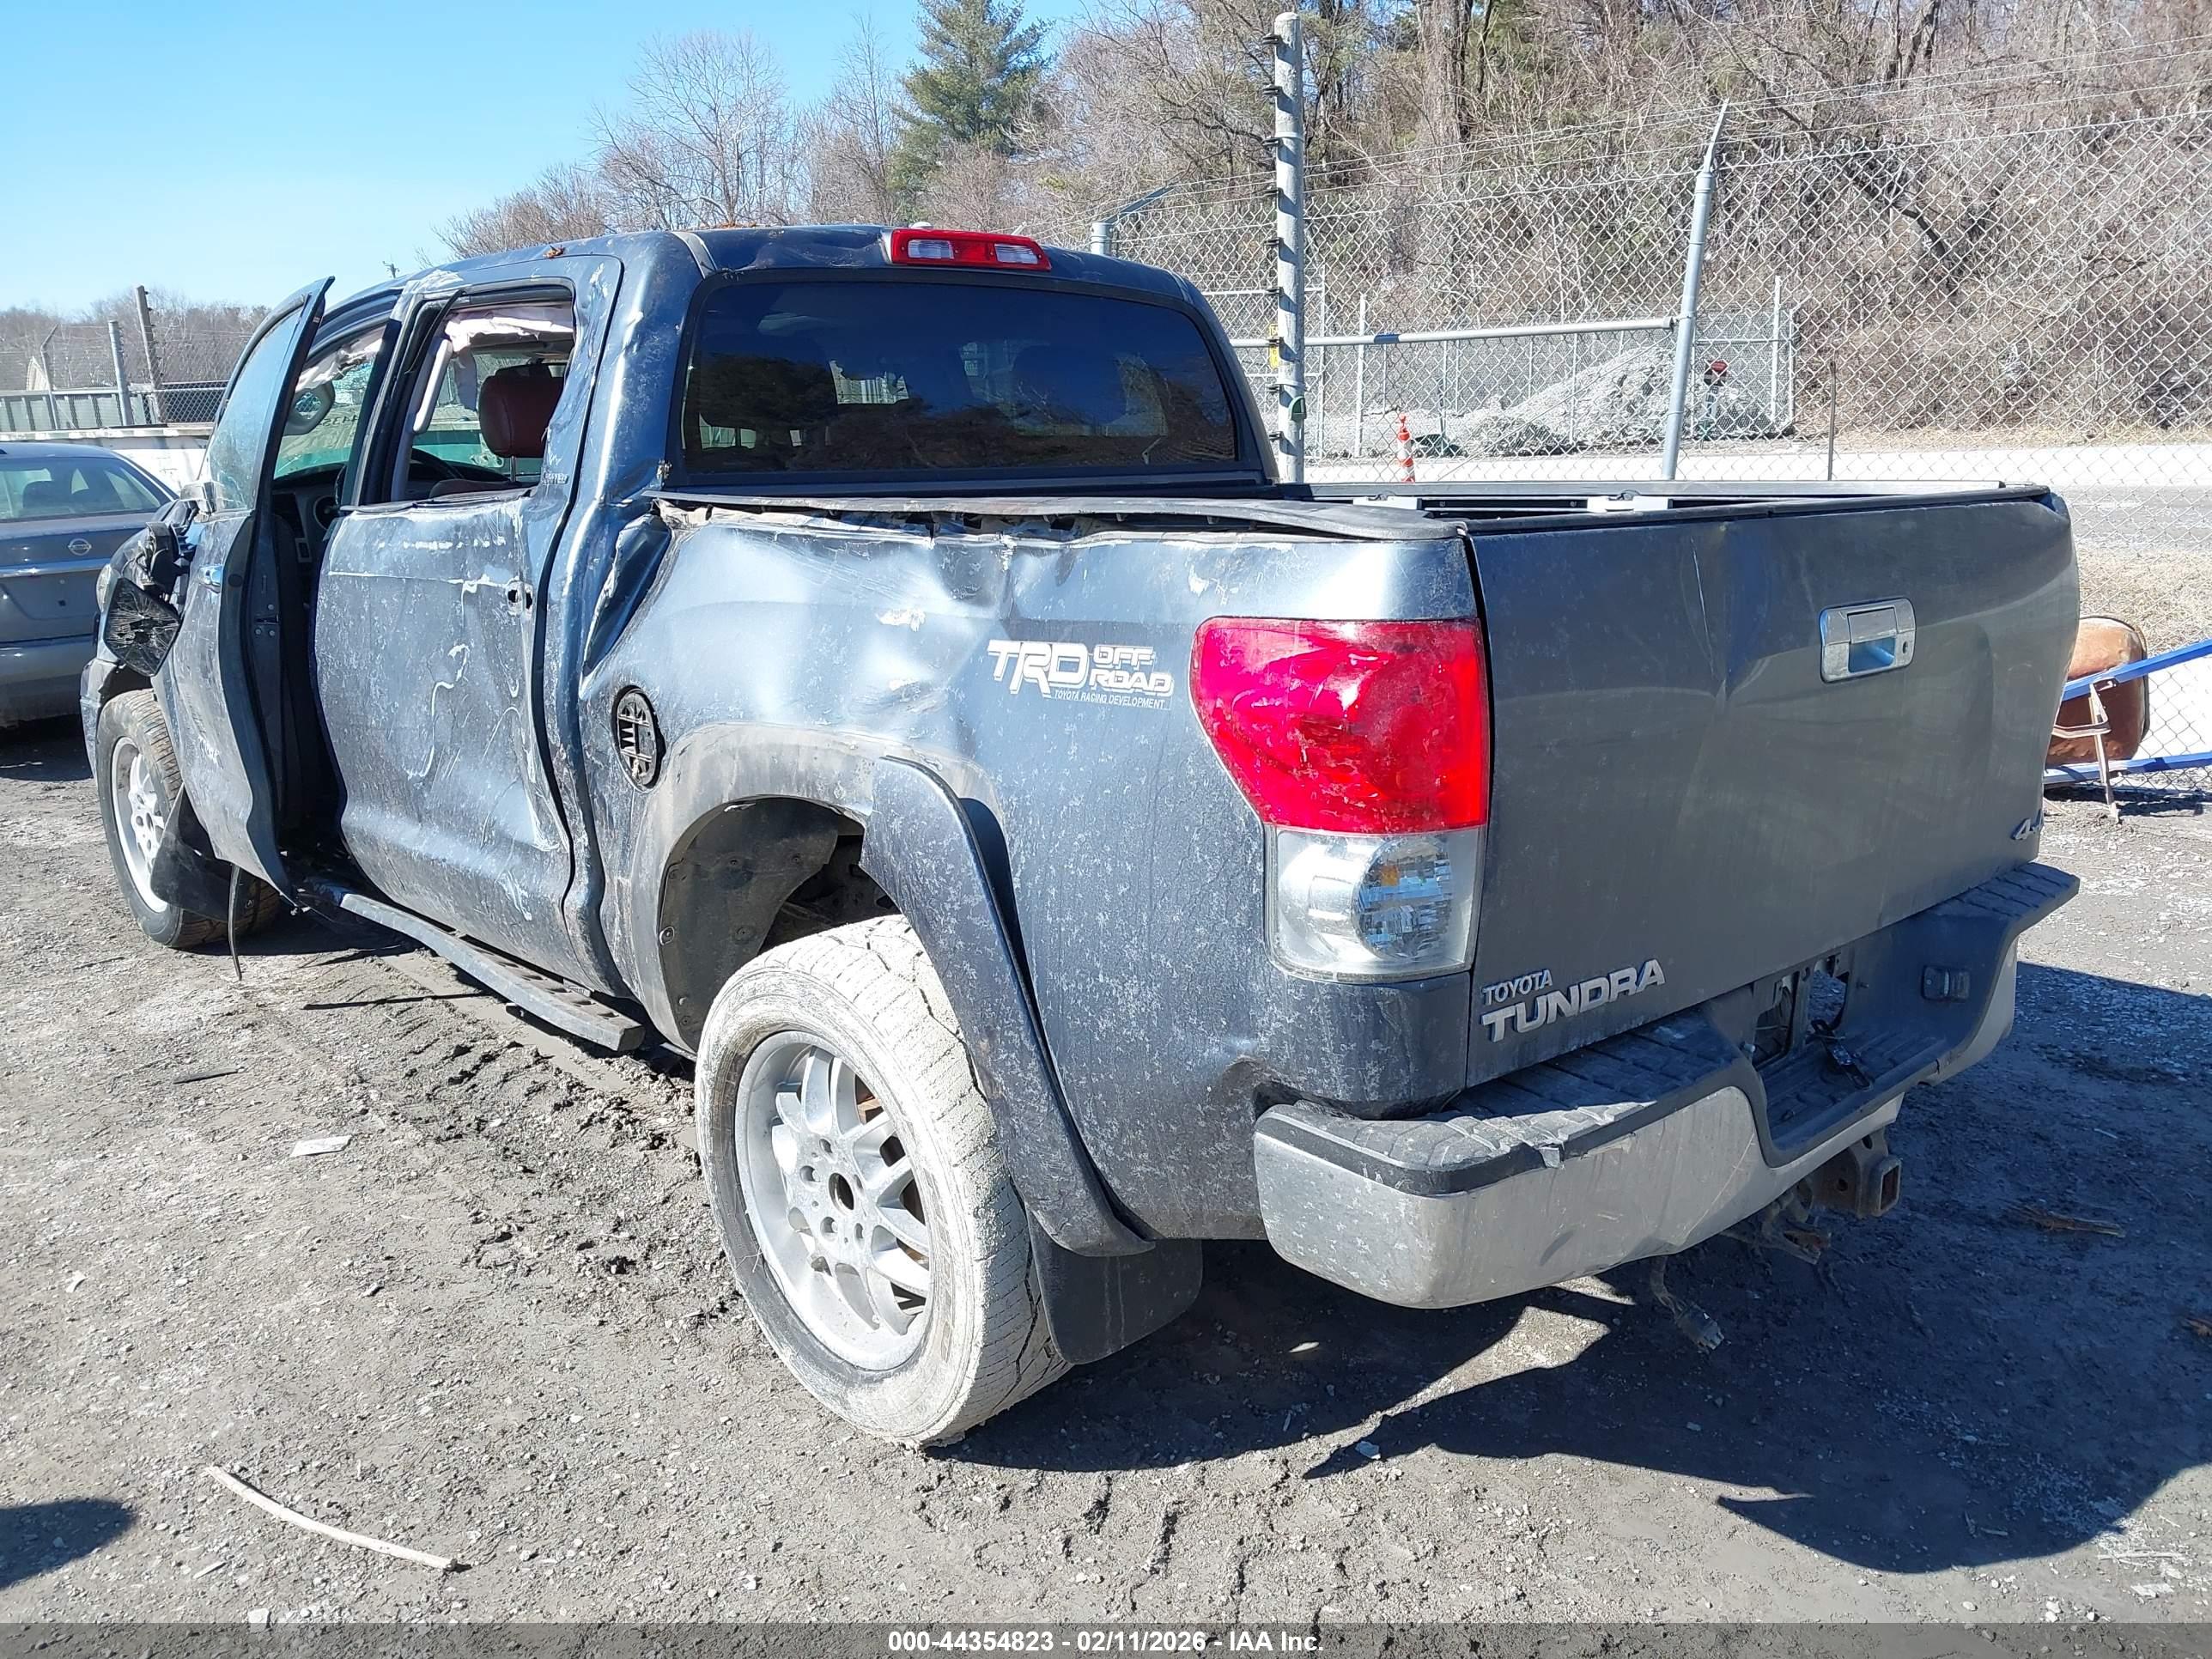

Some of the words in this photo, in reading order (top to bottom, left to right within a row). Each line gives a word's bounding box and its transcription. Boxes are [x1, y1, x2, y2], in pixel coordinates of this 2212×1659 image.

[988, 639, 1089, 698] TRD
[1092, 644, 1156, 670] OFF
[1054, 689, 1079, 702] TOYOTA
[1080, 692, 1107, 704] RACING
[1108, 696, 1166, 709] DEVELOPMENT
[1088, 668, 1175, 697] ROAD
[1481, 969, 1553, 1006] TOYOTA
[1481, 958, 1666, 1042] TUNDRA
